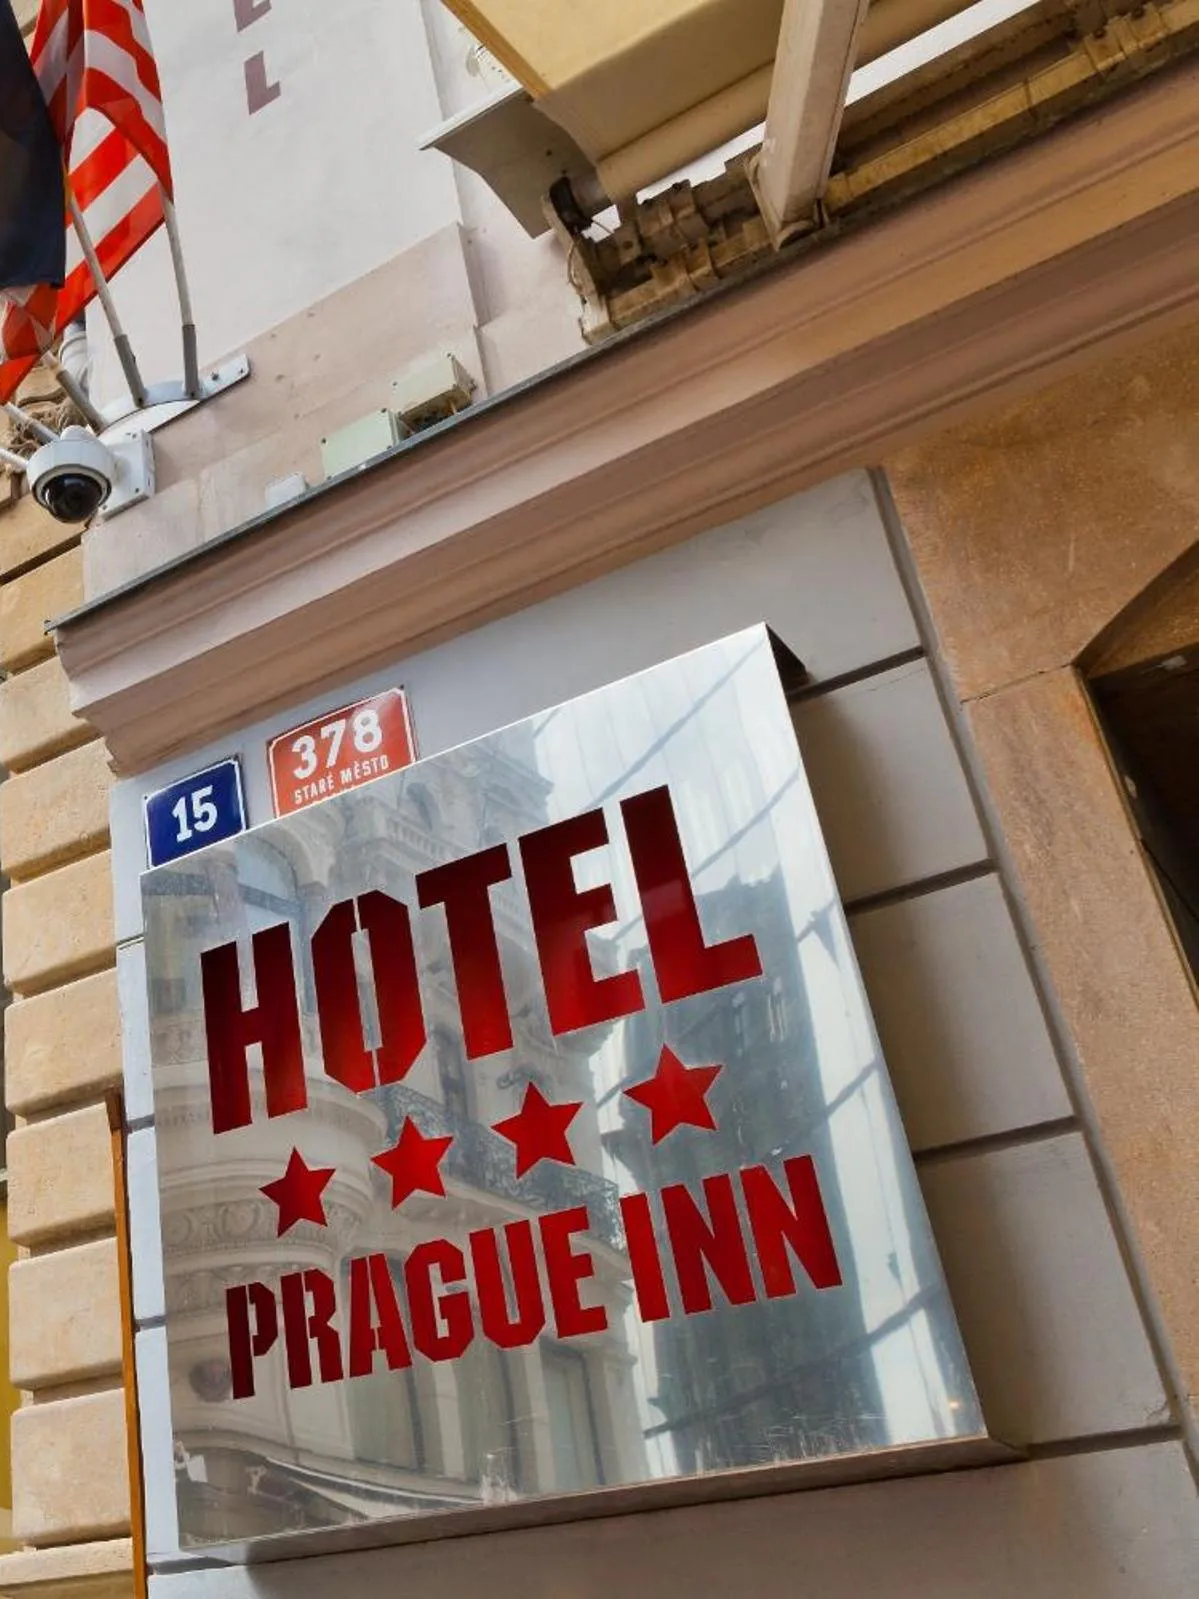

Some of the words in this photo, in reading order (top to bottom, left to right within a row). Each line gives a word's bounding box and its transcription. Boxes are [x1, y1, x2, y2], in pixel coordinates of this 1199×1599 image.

[171, 785, 218, 843] 15
[291, 709, 383, 780] 378
[200, 784, 763, 1135] HOTEL
[225, 1206, 609, 1400] PRAGUE
[618, 1153, 843, 1323] INN
